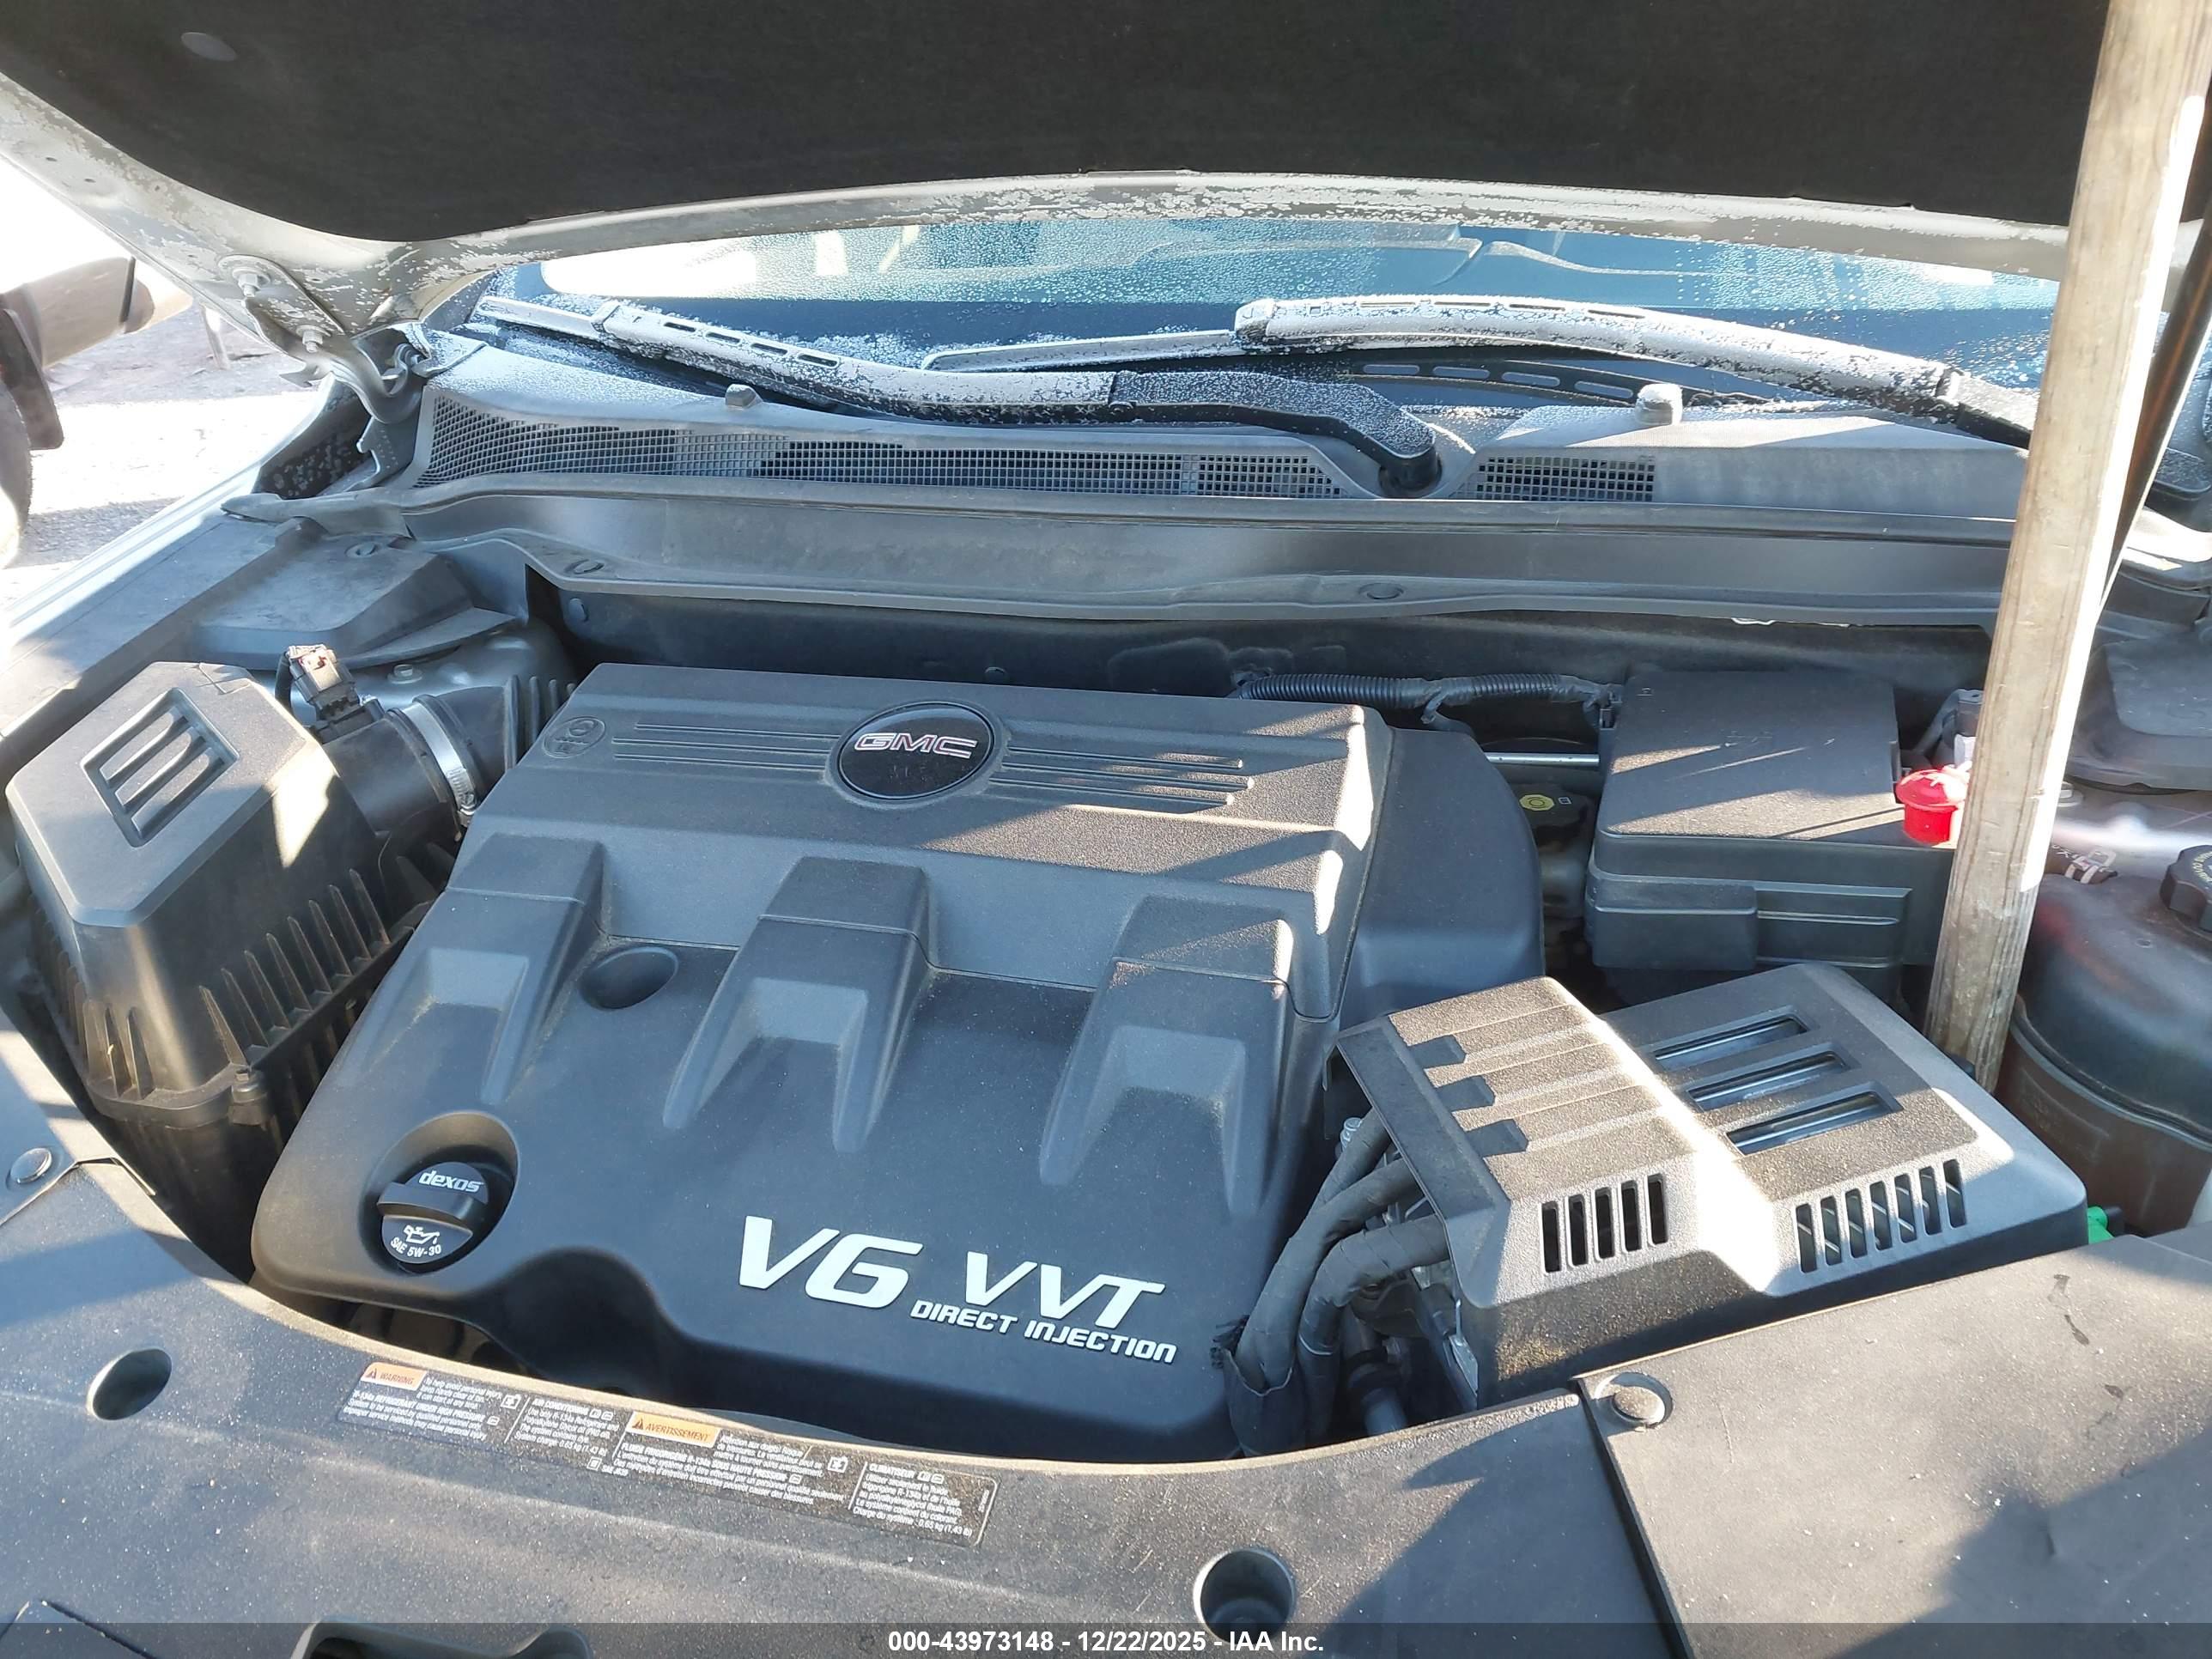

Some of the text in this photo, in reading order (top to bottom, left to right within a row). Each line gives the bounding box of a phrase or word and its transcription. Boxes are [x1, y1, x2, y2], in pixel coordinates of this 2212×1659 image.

[854, 732, 977, 759] GMC
[419, 1170, 484, 1193] dexos
[390, 1237, 441, 1258] SAE 5W-30
[739, 1215, 1165, 1329] V6 VVT
[910, 1298, 1176, 1364] DIRECT INJECTION
[380, 1372, 415, 1385] WARNING
[646, 1423, 710, 1441] AVERTISSEMENT
[869, 1462, 915, 1479] CLIMATISEUR
